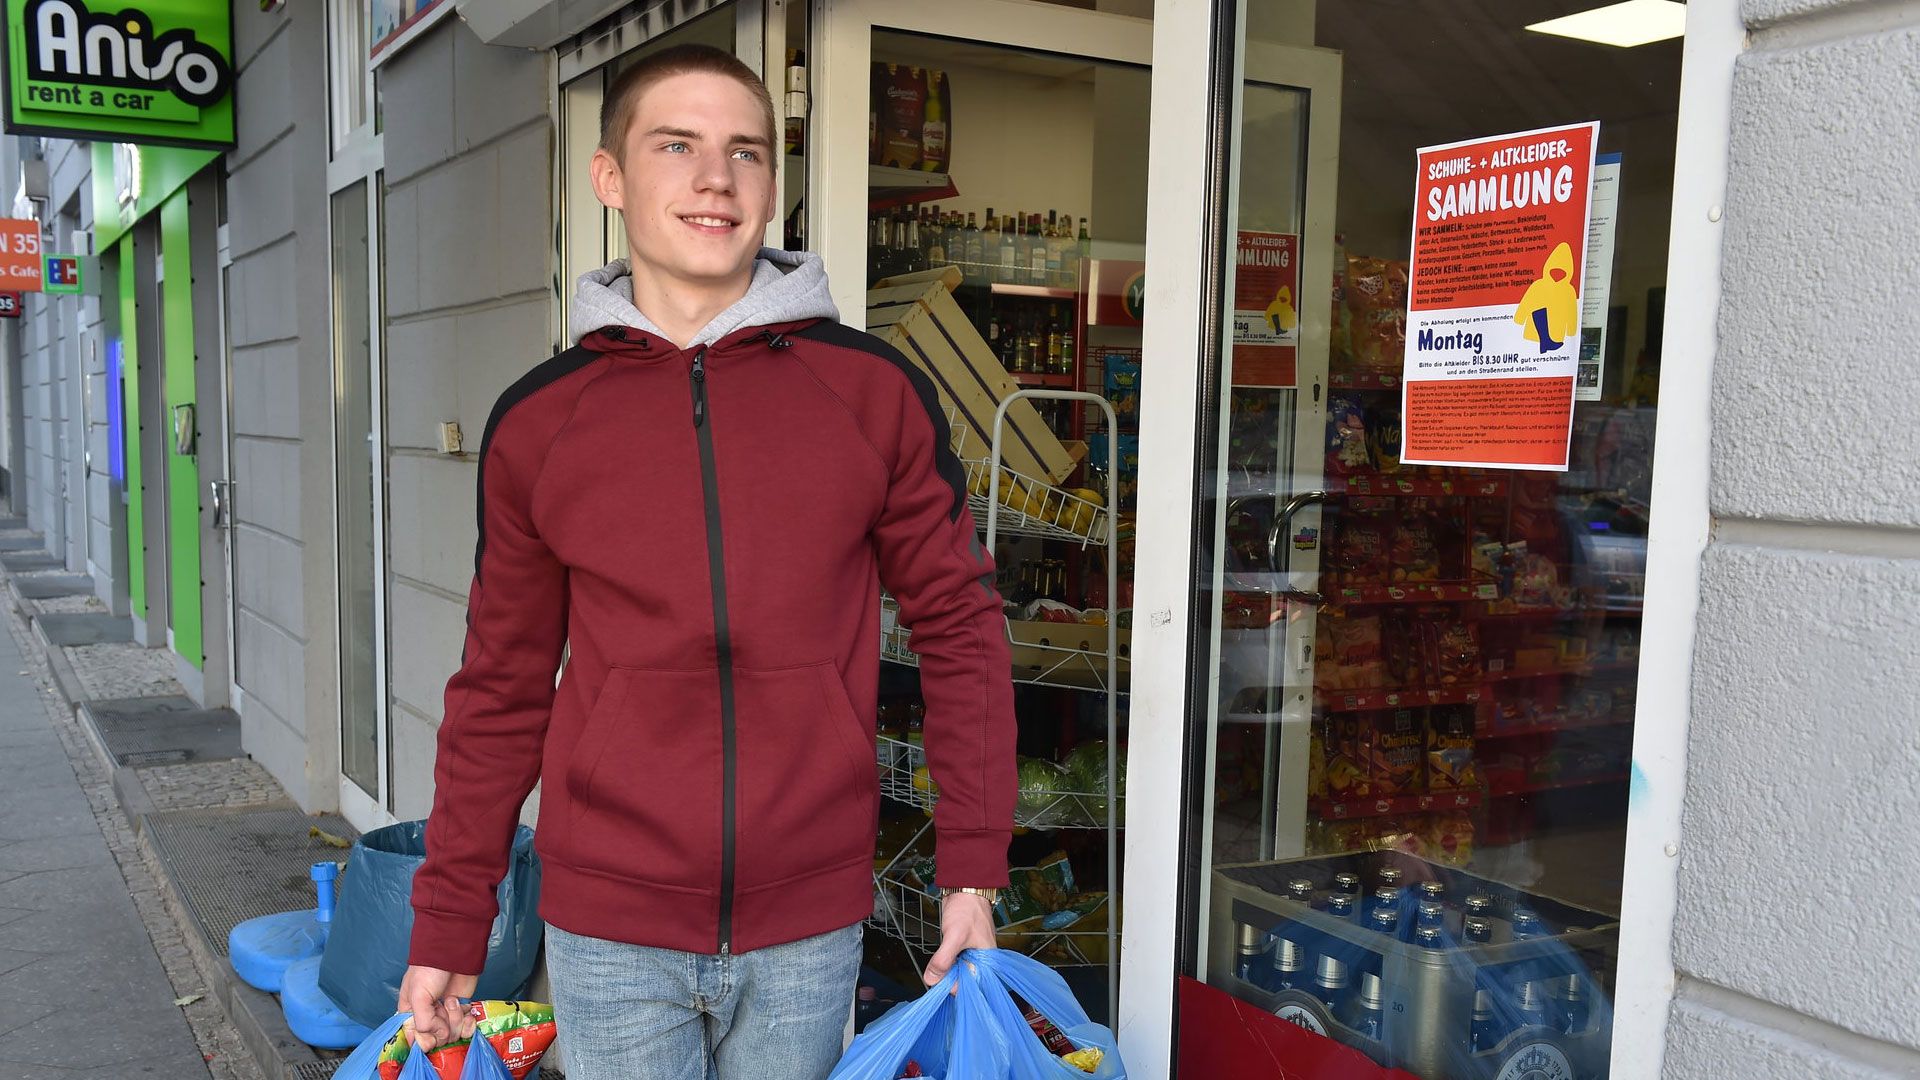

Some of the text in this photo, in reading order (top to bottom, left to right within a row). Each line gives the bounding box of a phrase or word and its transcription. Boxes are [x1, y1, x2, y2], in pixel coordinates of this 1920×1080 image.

[36, 0, 218, 95] Aniso
[28, 85, 155, 110] rent a car
[1428, 139, 1573, 180] SCHUHE- + ALTKLEIDER-
[1427, 164, 1573, 221] SAMMLUNG
[1419, 227, 1431, 236] WIR
[1433, 222, 1464, 235] SAMMELN:
[14, 233, 39, 255] 35
[10, 264, 39, 277] Cafe
[1417, 265, 1442, 276] JEDOCH
[1443, 263, 1464, 274] KEINE:
[1418, 328, 1482, 354] Montag
[1472, 355, 1484, 365] BIS
[1485, 355, 1501, 364] 8.30
[1502, 353, 1519, 363] UHR
[1533, 354, 1570, 362] verschnüren
